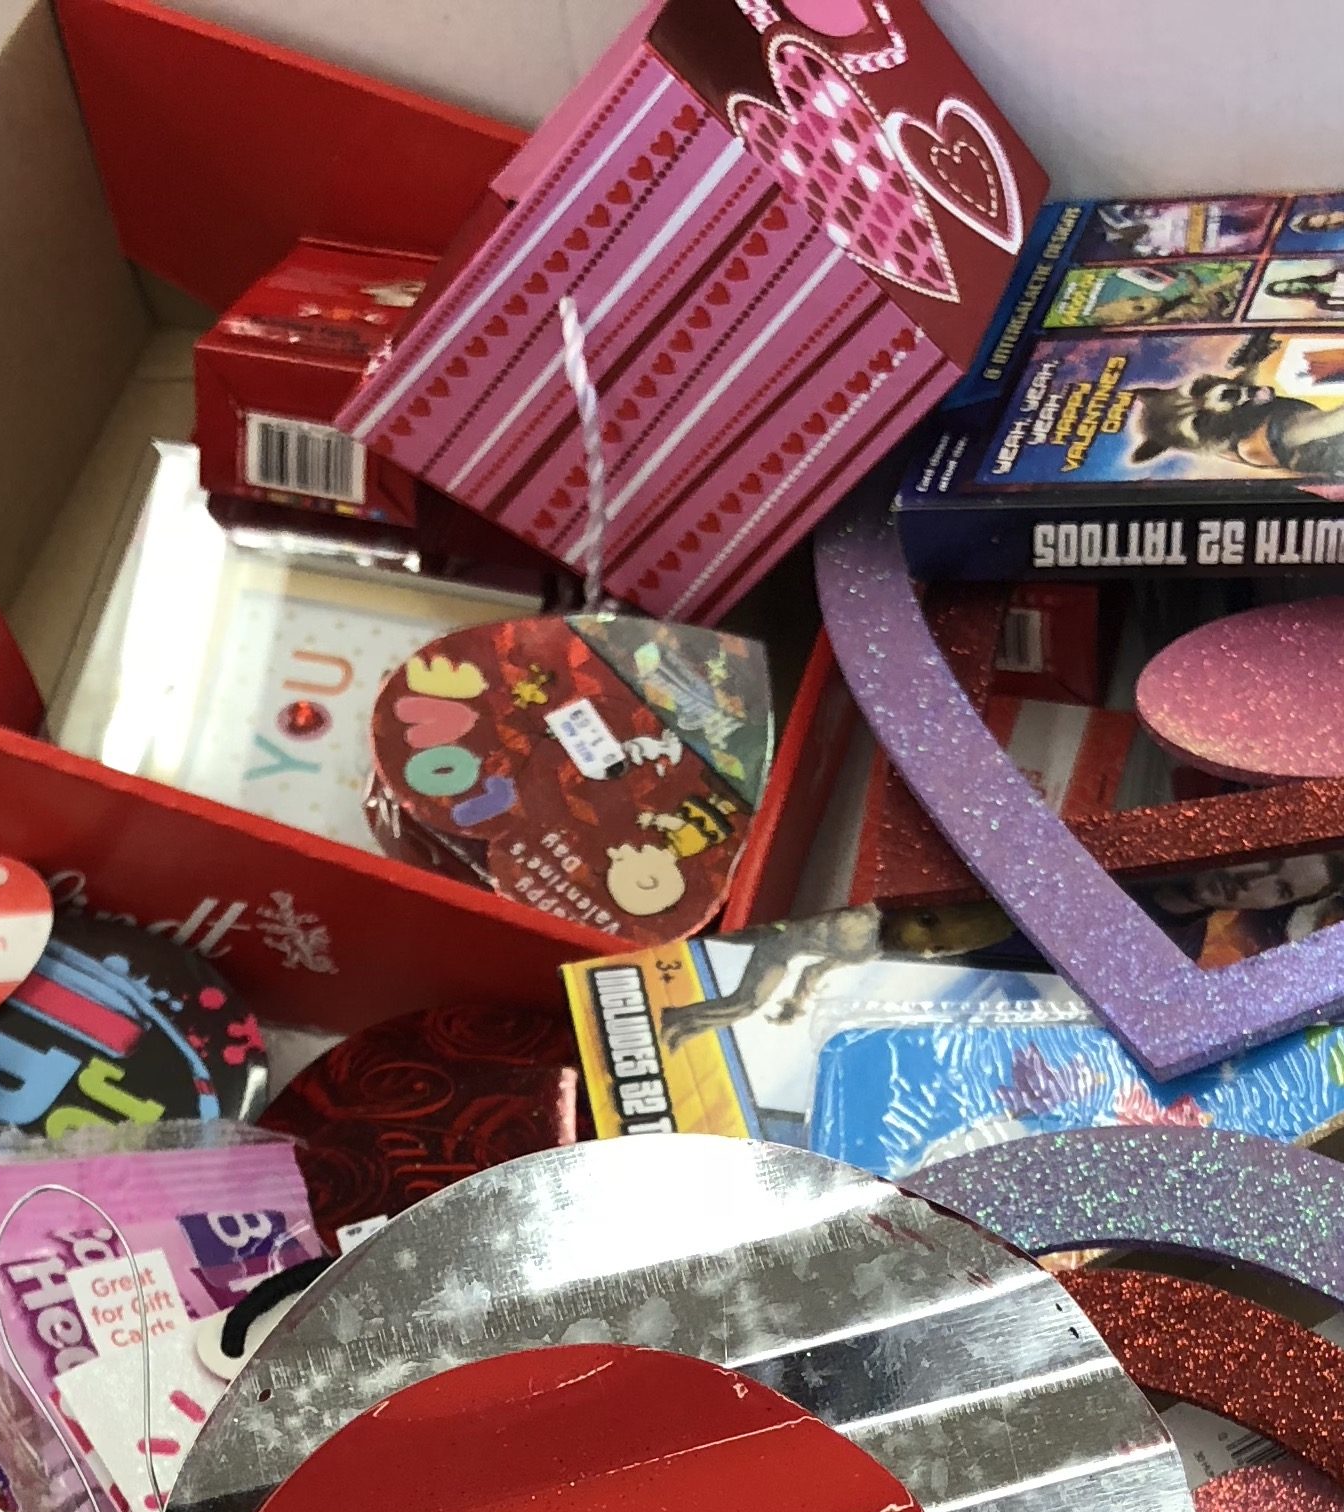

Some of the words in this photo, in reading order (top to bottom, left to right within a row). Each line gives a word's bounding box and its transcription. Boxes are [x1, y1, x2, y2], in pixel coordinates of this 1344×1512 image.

[1048, 380, 1092, 446] HAPPY
[1061, 352, 1127, 472] VALENTINE'S
[1033, 521, 1187, 567] TATTOOS
[1198, 521, 1246, 564] 32
[538, 829, 583, 874] Day
[509, 838, 621, 936] Valentine's
[655, 959, 682, 983] 3+
[594, 966, 661, 1080] INCLUDES
[618, 1077, 669, 1116] 32
[91, 1267, 156, 1298] Great
[92, 1303, 124, 1327] for
[131, 1290, 175, 1317] Gift
